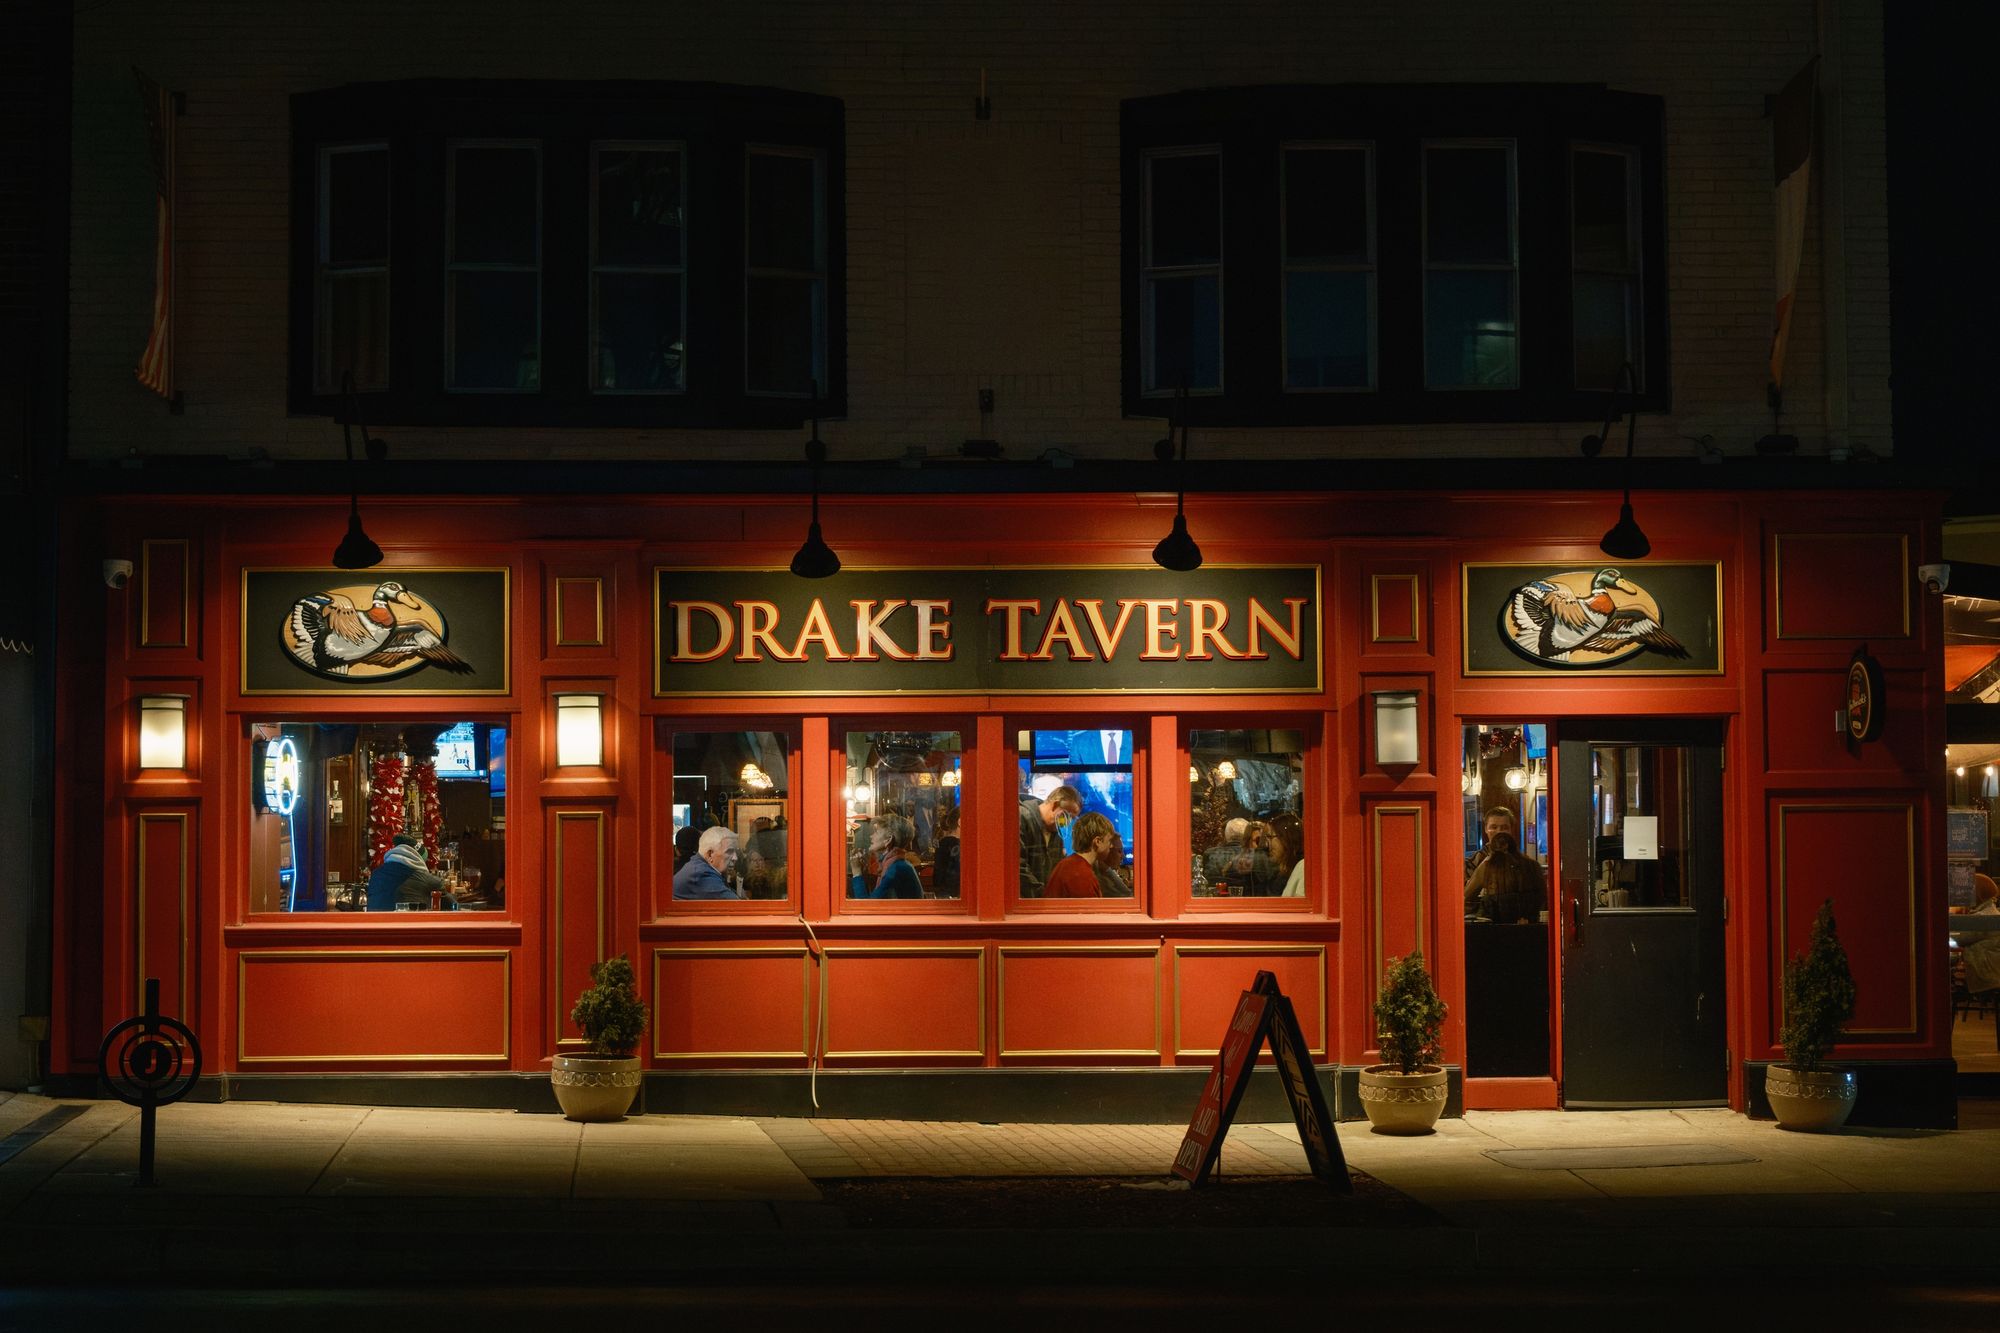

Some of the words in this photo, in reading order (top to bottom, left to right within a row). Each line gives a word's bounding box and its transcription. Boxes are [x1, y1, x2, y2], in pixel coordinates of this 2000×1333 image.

[669, 599, 954, 663] DRAKE
[986, 598, 1310, 663] TAVERN
[1178, 1139, 1203, 1170] OPEN
